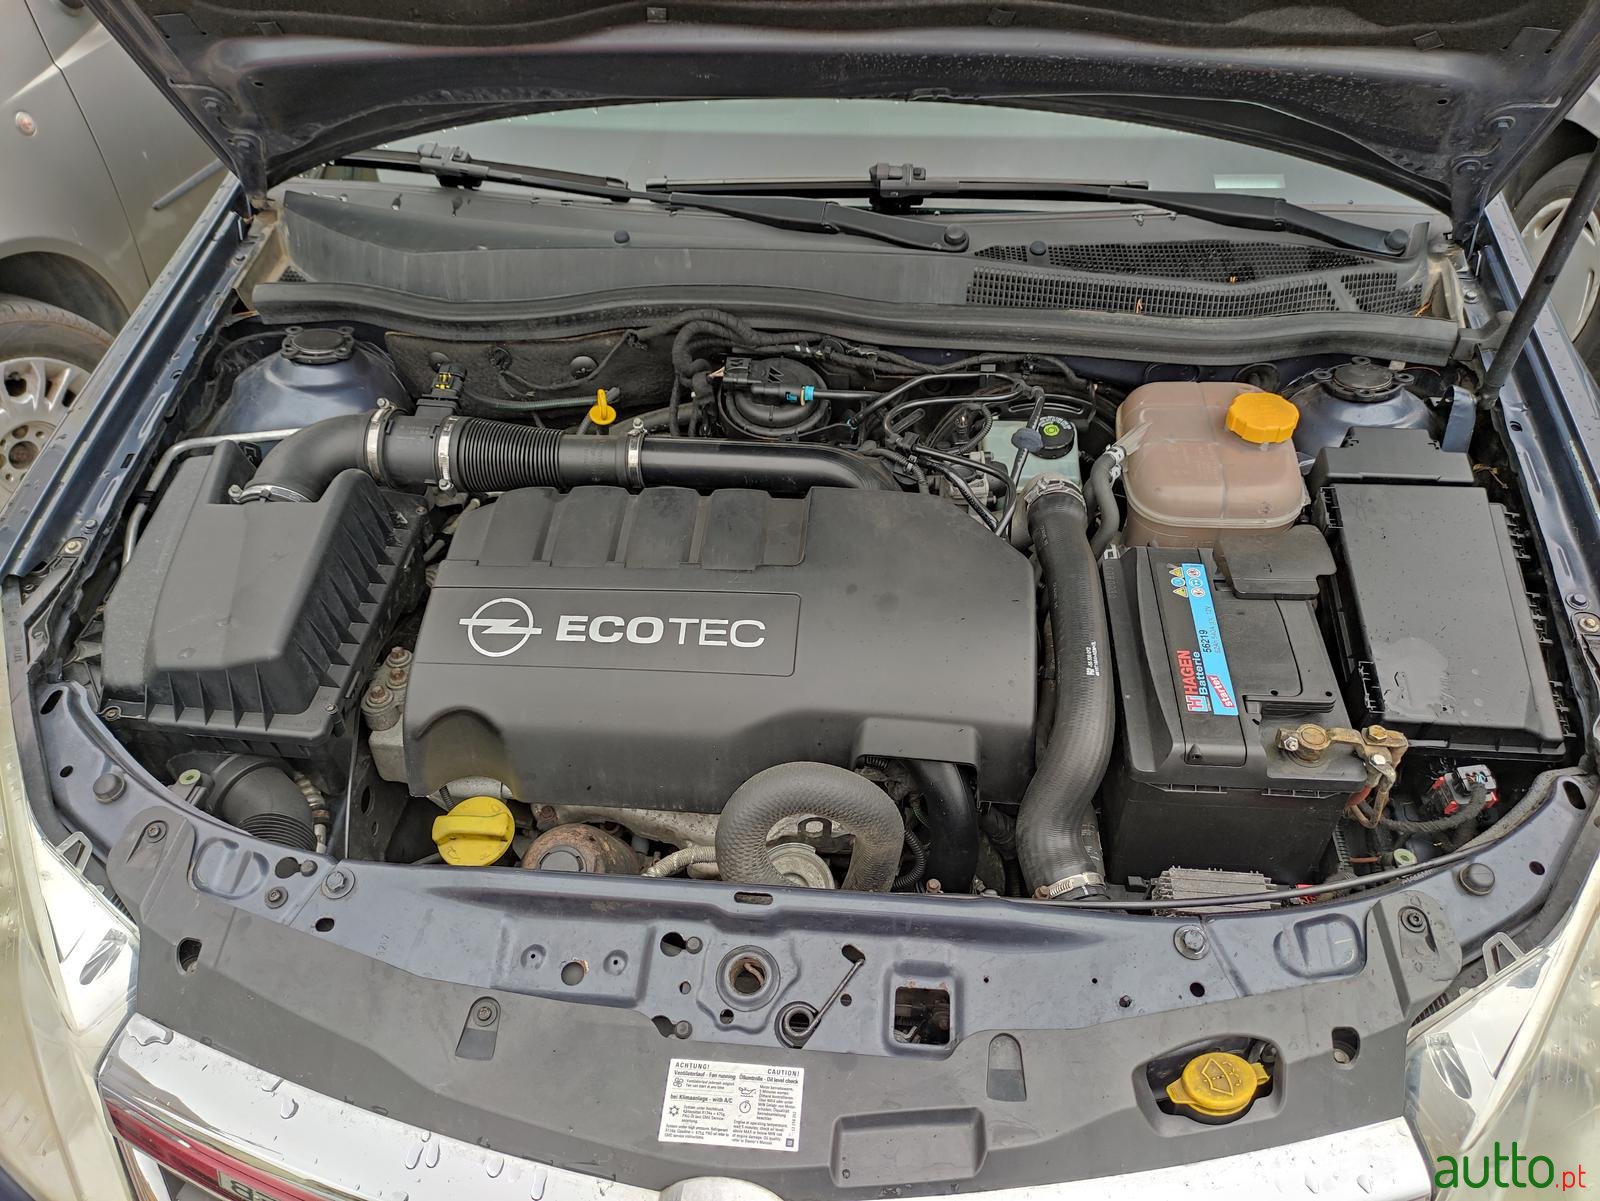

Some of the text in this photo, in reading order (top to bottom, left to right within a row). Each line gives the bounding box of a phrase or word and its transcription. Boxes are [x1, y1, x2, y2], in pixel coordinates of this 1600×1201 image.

[556, 614, 766, 648] ECOTEC
[1199, 630, 1212, 652] 56219
[1177, 650, 1199, 695] HAGEN
[1192, 651, 1208, 696] Batterie
[1211, 676, 1234, 708] starter
